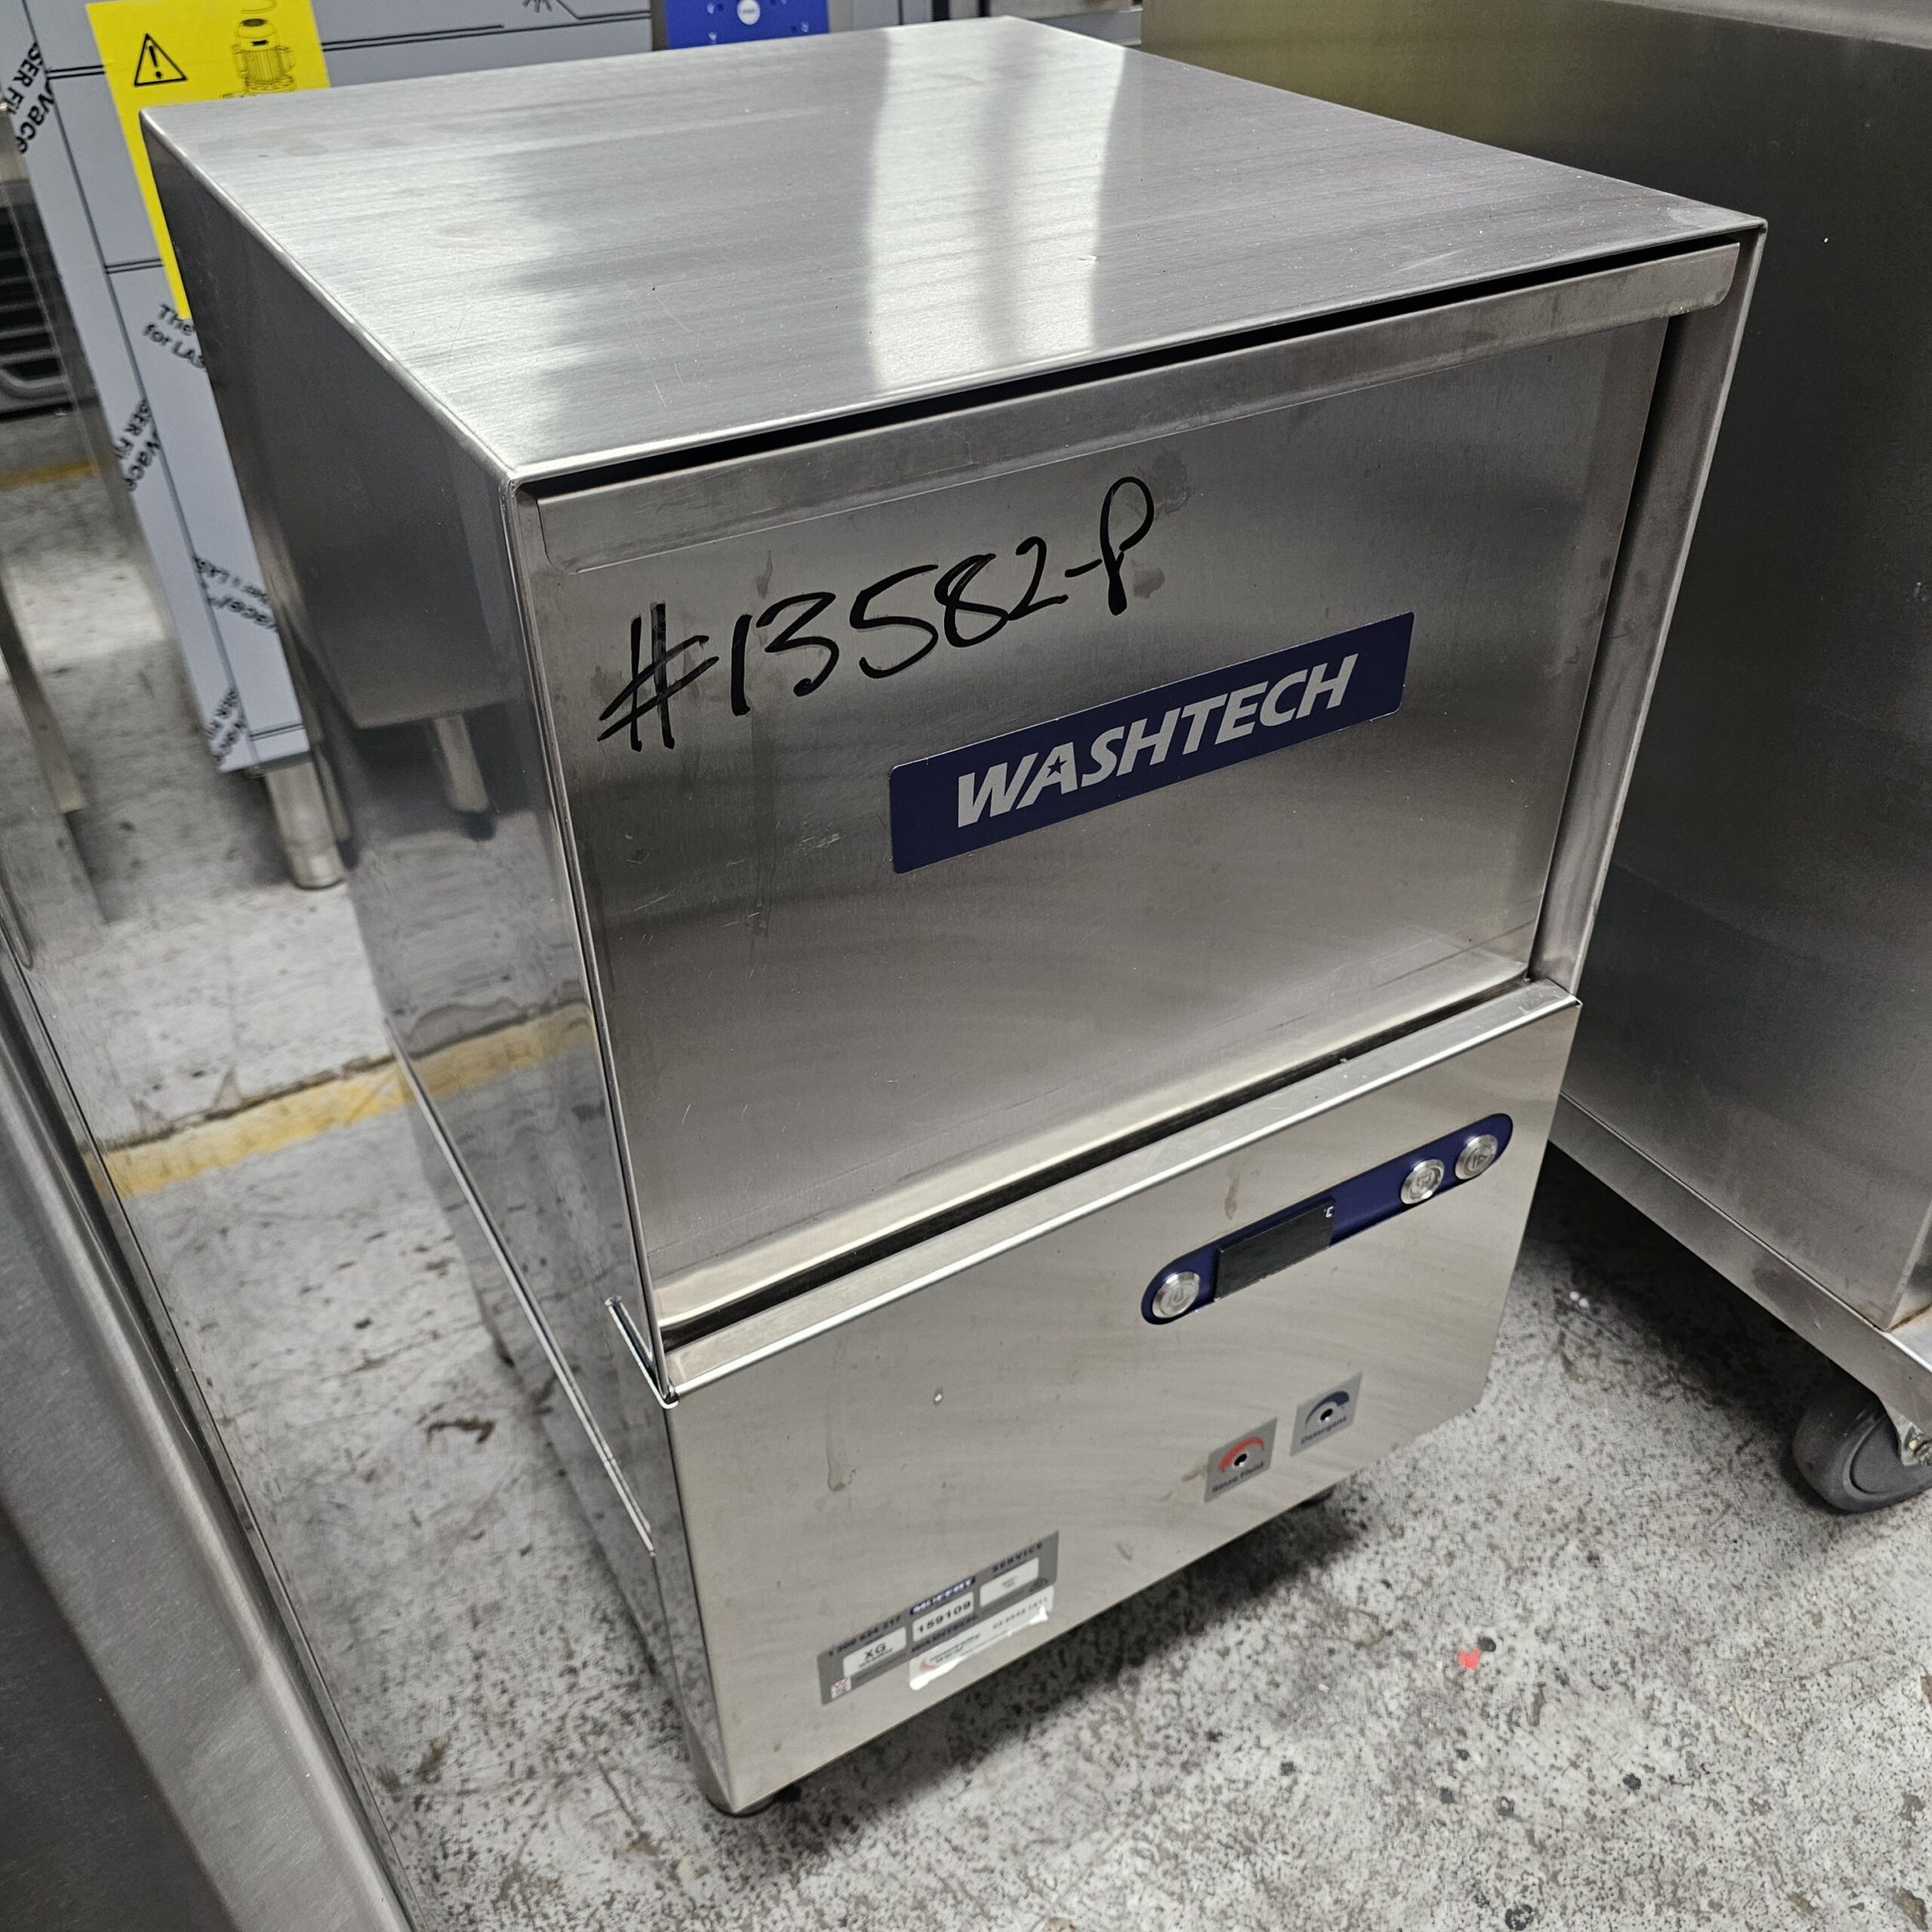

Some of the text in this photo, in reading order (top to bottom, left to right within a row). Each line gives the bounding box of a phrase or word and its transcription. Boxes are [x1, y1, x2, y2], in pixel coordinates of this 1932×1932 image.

[957, 653, 1359, 829] WASHTECH
[917, 1601, 971, 1632] 159109
[863, 1642, 887, 1661] XG
